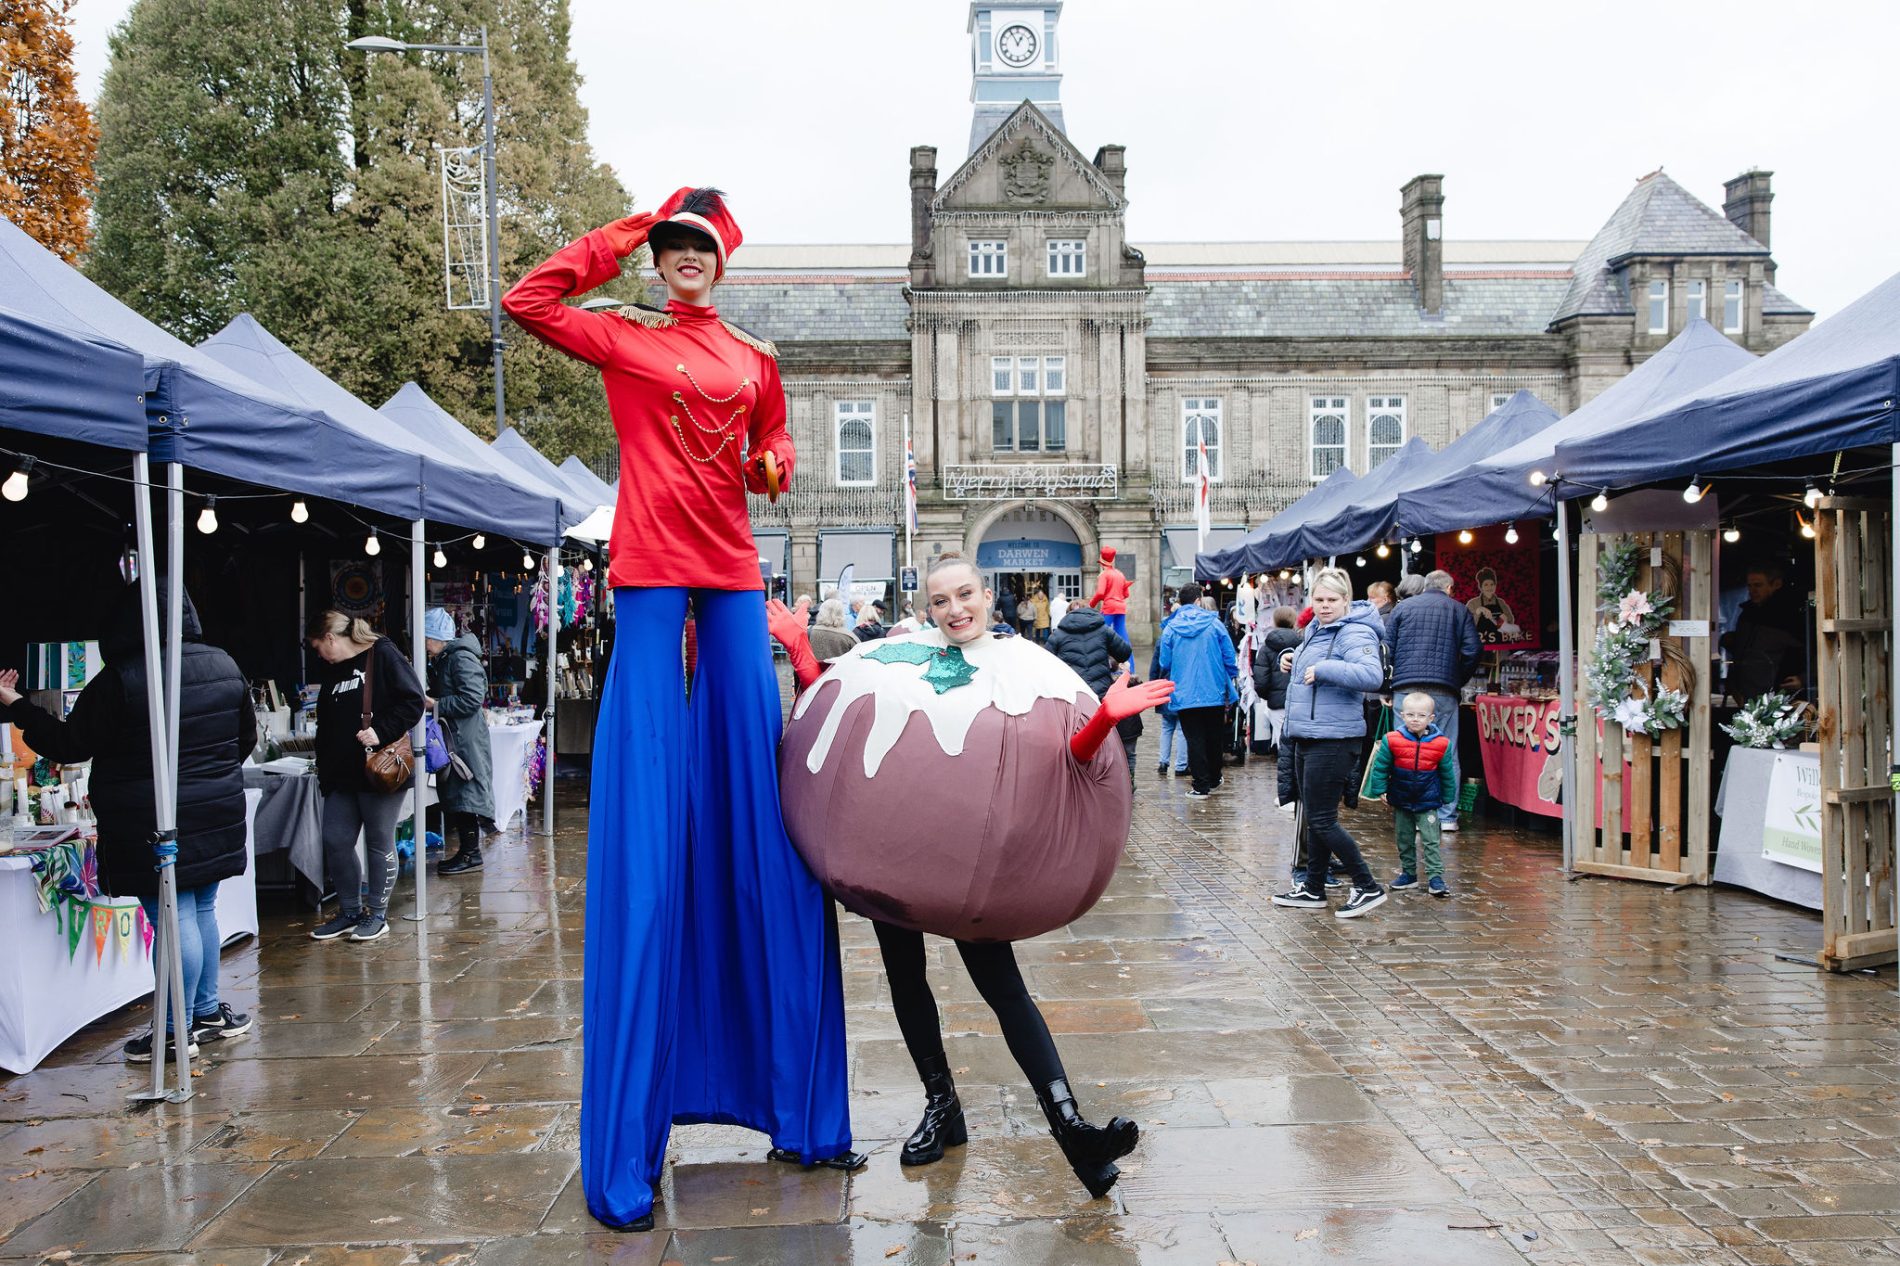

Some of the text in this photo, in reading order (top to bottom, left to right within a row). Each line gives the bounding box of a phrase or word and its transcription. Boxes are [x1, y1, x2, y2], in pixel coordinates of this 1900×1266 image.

[947, 466, 1116, 498] Merry Christmas
[998, 549, 1049, 559] DARWEN
[1002, 558, 1045, 567] MARKET
[1478, 702, 1561, 754] BAKER'S
[1796, 765, 1821, 787] Will
[380, 850, 396, 904] WILLS
